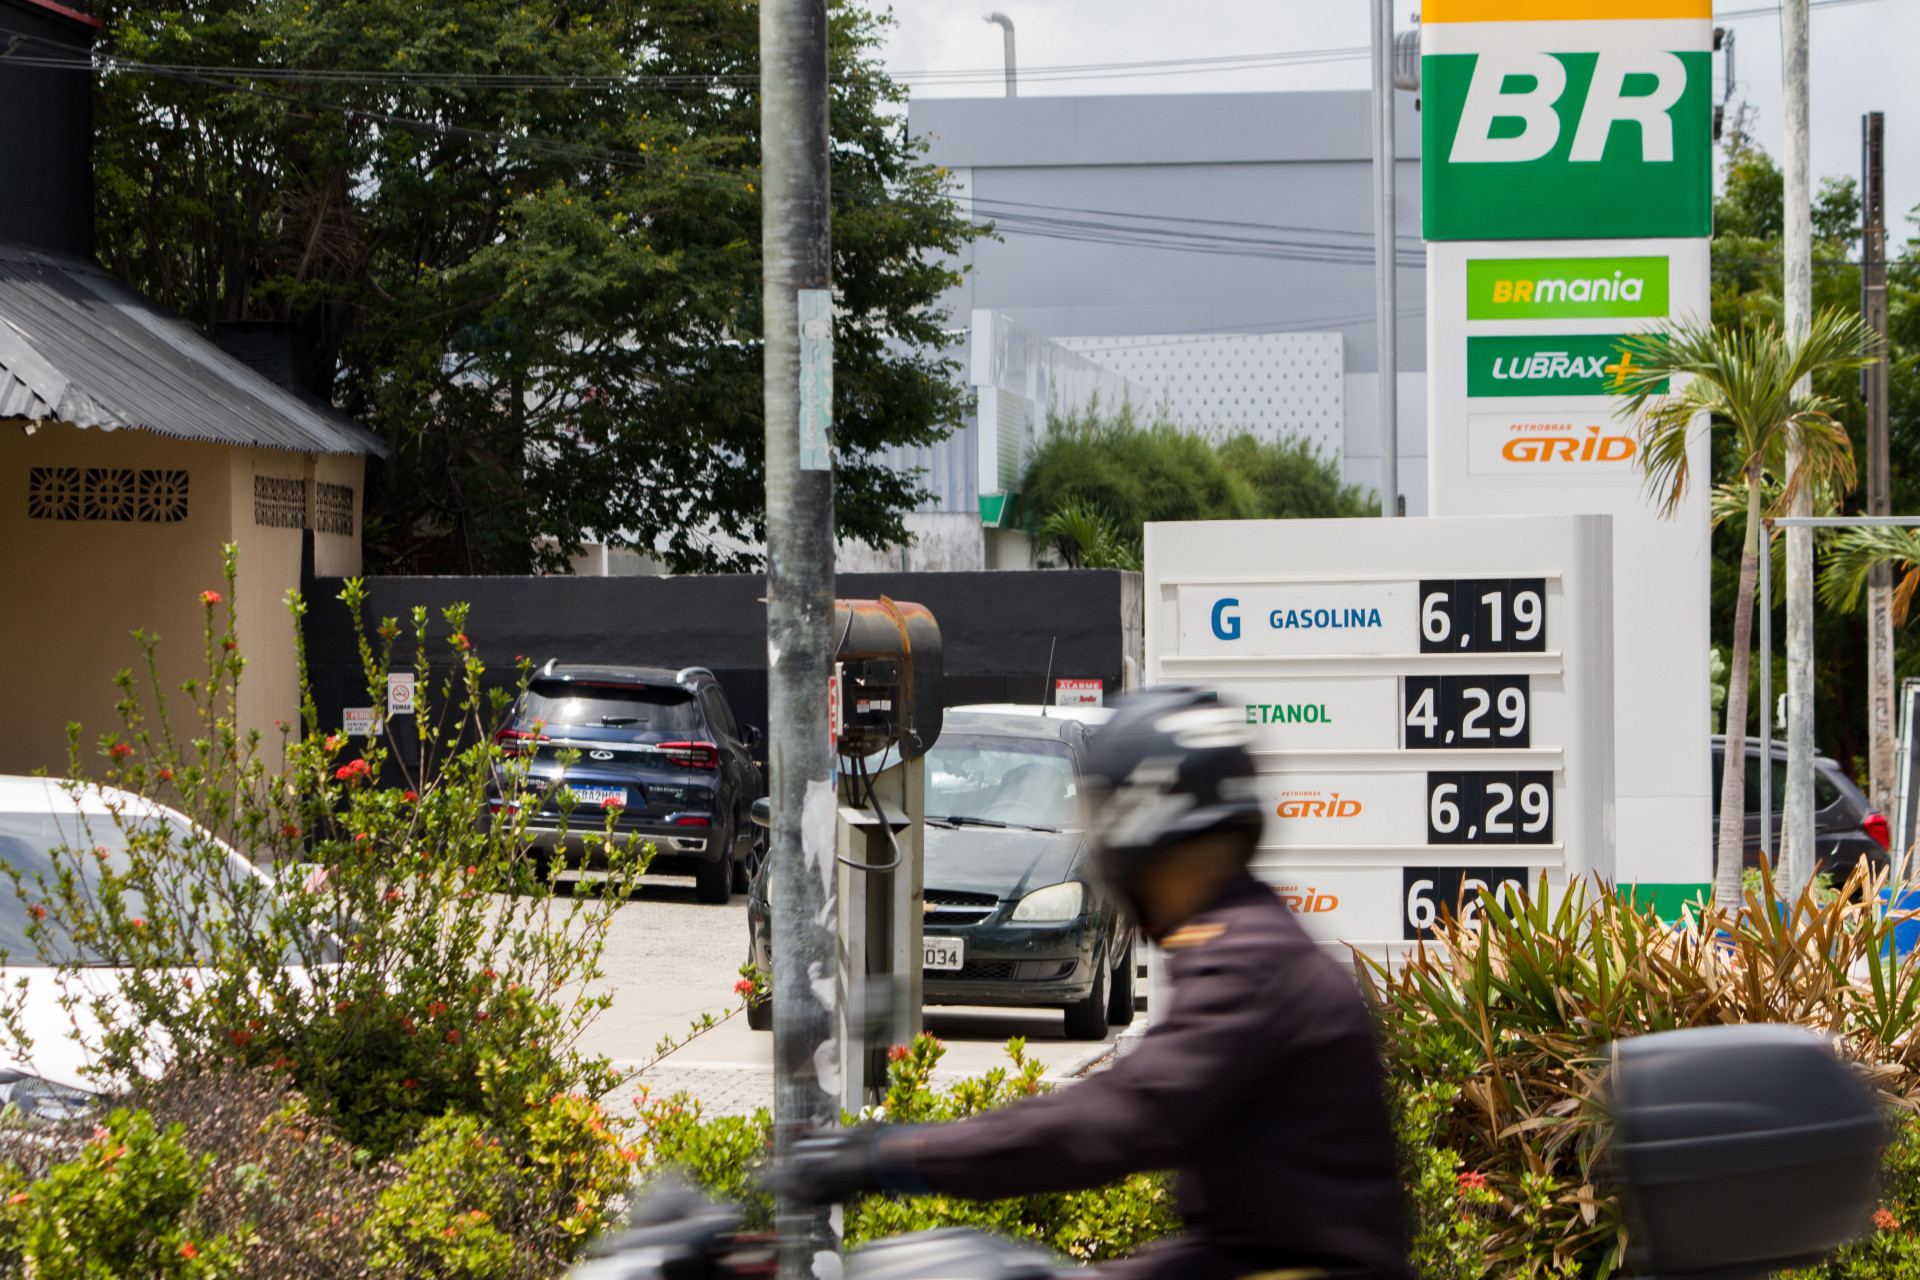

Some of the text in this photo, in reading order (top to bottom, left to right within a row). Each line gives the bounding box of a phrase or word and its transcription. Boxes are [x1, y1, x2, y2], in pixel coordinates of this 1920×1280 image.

[1449, 50, 1687, 162] BR
[1493, 270, 1644, 303] BRmania
[1502, 426, 1637, 462] GRID
[1211, 598, 1382, 640] G GASOLINA
[1422, 591, 1542, 647] 6,19
[1060, 682, 1099, 690] ALARME
[1245, 704, 1332, 724] ETANOL
[1407, 688, 1526, 743] 4,29
[1276, 792, 1362, 818] GRID
[1431, 783, 1550, 839] 6,29
[1278, 887, 1339, 913] RID
[923, 949, 957, 966] 034
